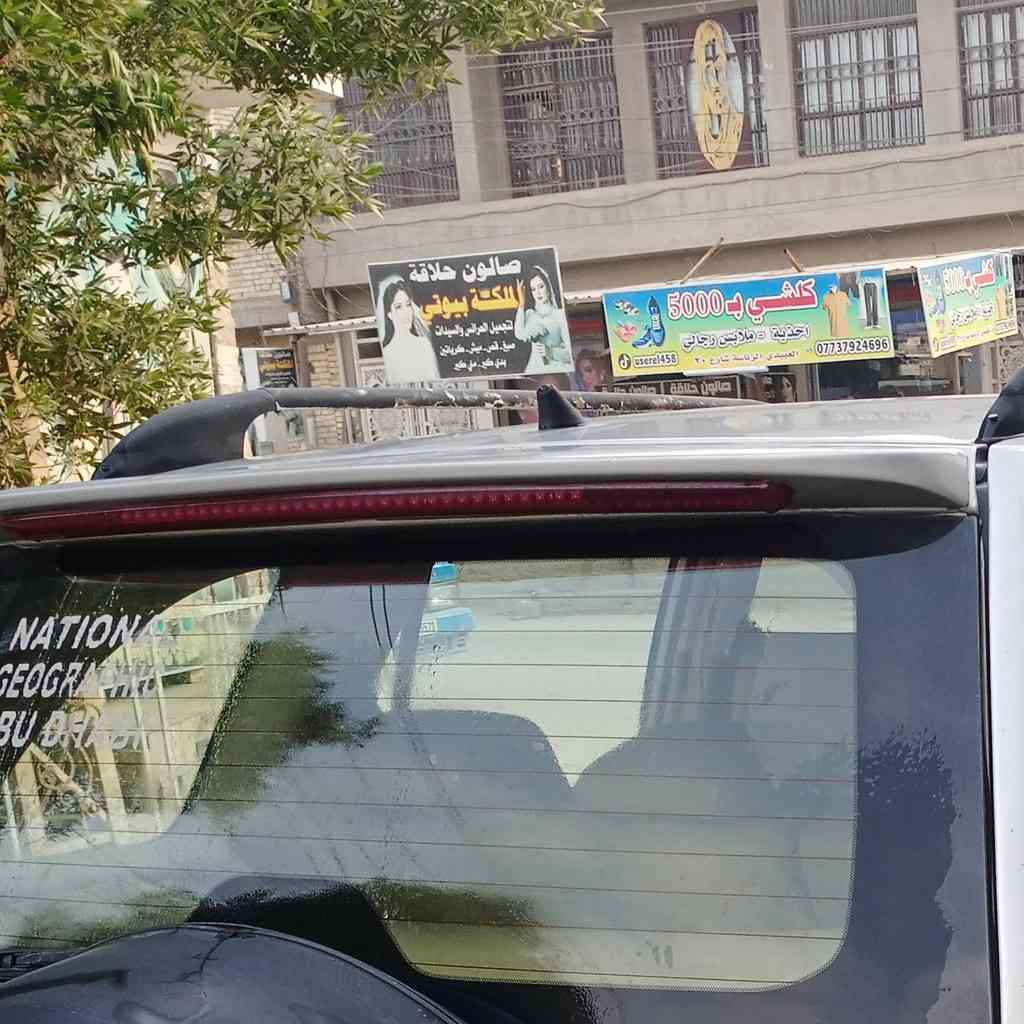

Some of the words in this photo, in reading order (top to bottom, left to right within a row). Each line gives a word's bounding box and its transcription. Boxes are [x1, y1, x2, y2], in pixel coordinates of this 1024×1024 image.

[409, 262, 457, 283] حلاقة
[462, 256, 522, 283] صالون
[667, 289, 725, 321] 5000
[816, 339, 889, 355] 07737924696
[701, 381, 732, 396] صالون
